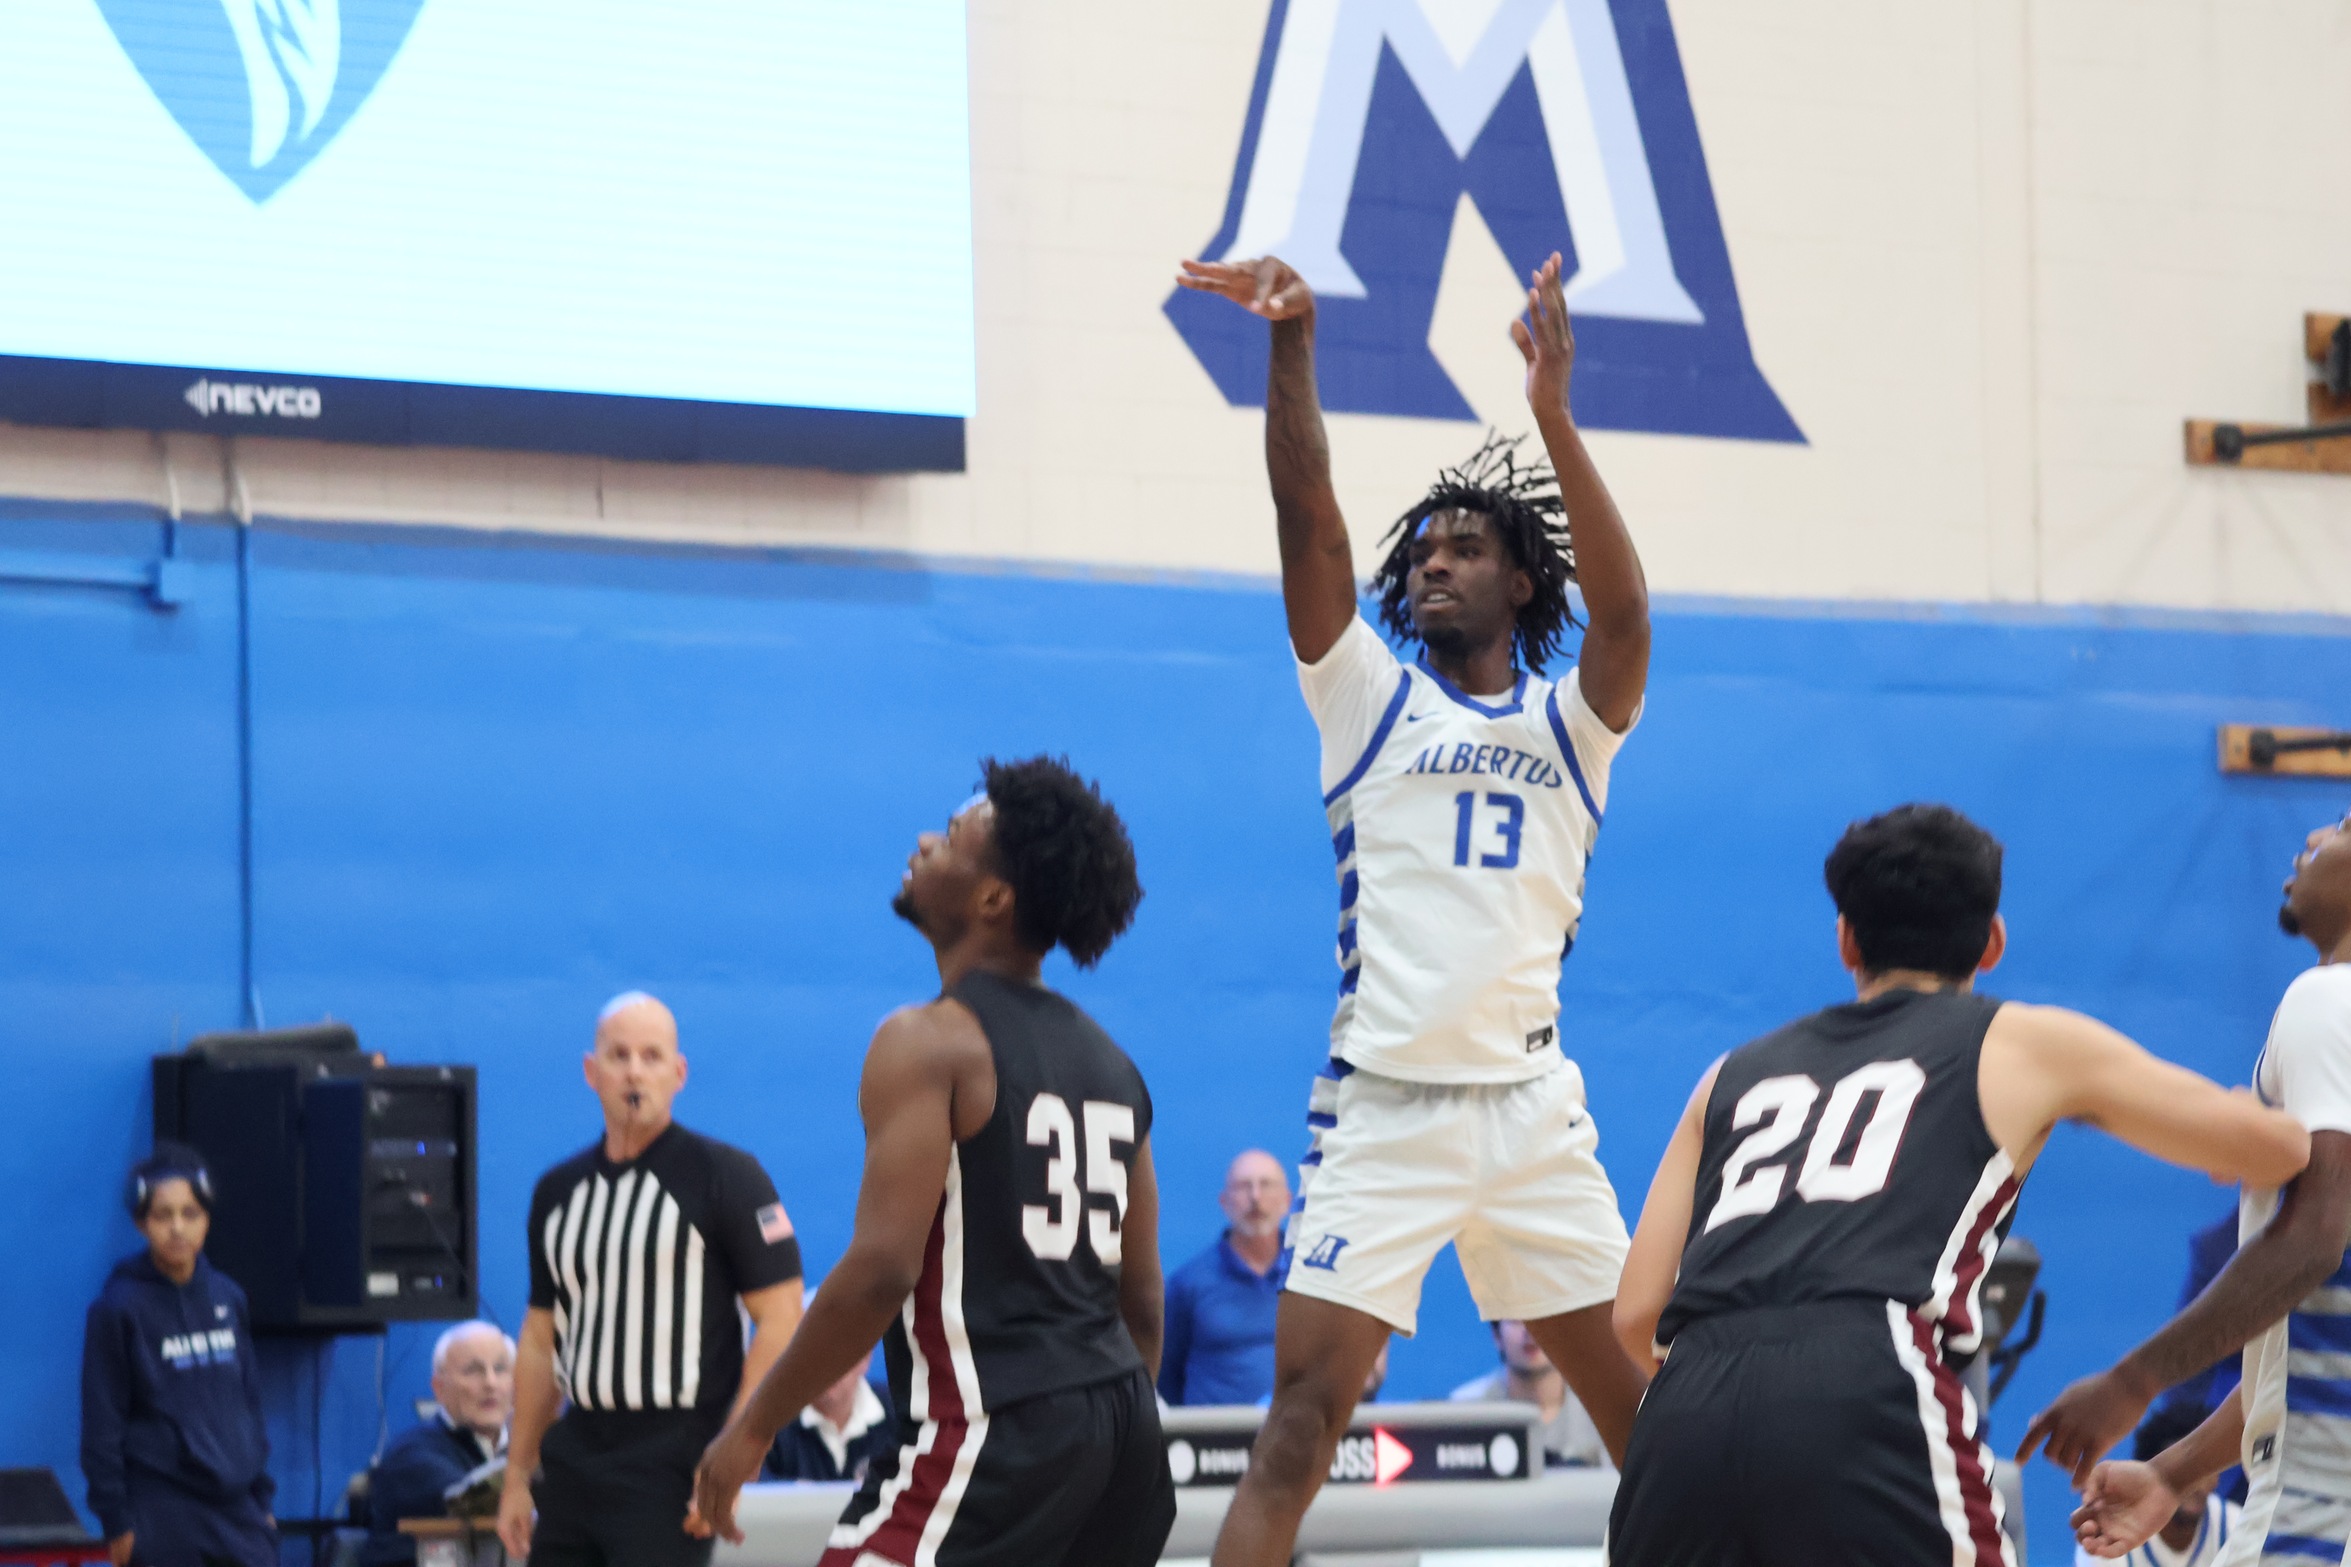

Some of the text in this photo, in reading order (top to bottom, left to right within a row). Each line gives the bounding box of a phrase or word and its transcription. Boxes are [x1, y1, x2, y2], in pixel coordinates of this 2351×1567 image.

[209, 382, 322, 419] NEVCO
[1404, 742, 1562, 789] ALBERTUS
[1454, 790, 1525, 869] 13
[1703, 1057, 1927, 1236] 20
[1022, 1092, 1136, 1266] 35
[1330, 1437, 1376, 1479] OSS
